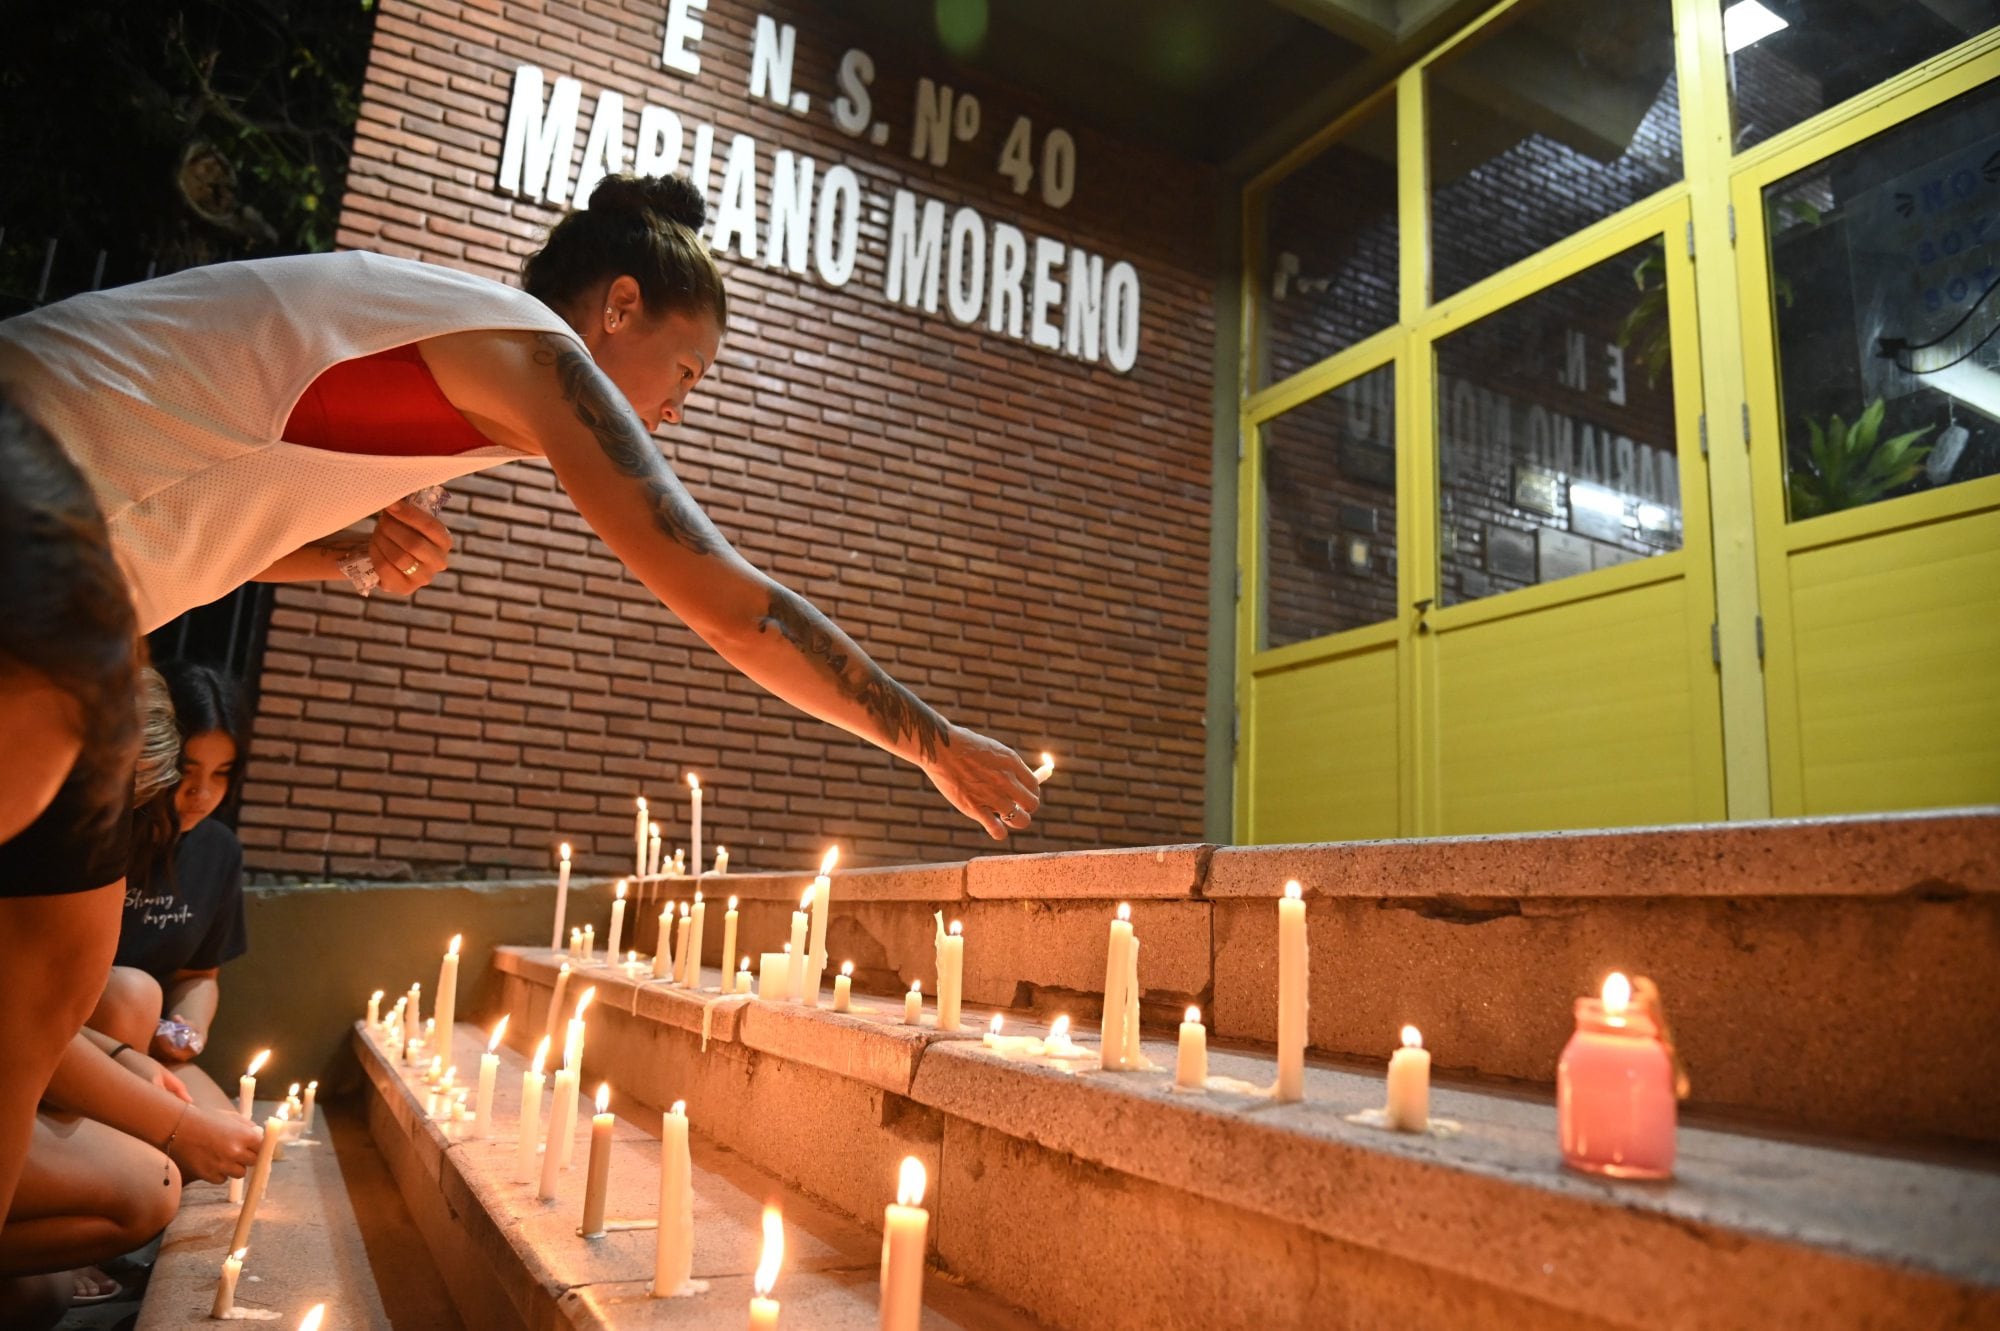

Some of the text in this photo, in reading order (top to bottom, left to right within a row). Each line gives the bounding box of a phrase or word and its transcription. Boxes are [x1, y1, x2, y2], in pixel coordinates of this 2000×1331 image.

[750, 14, 809, 114] N.
[833, 48, 890, 146] S.
[998, 116, 1076, 208] 40
[885, 189, 1141, 373] MORENO
